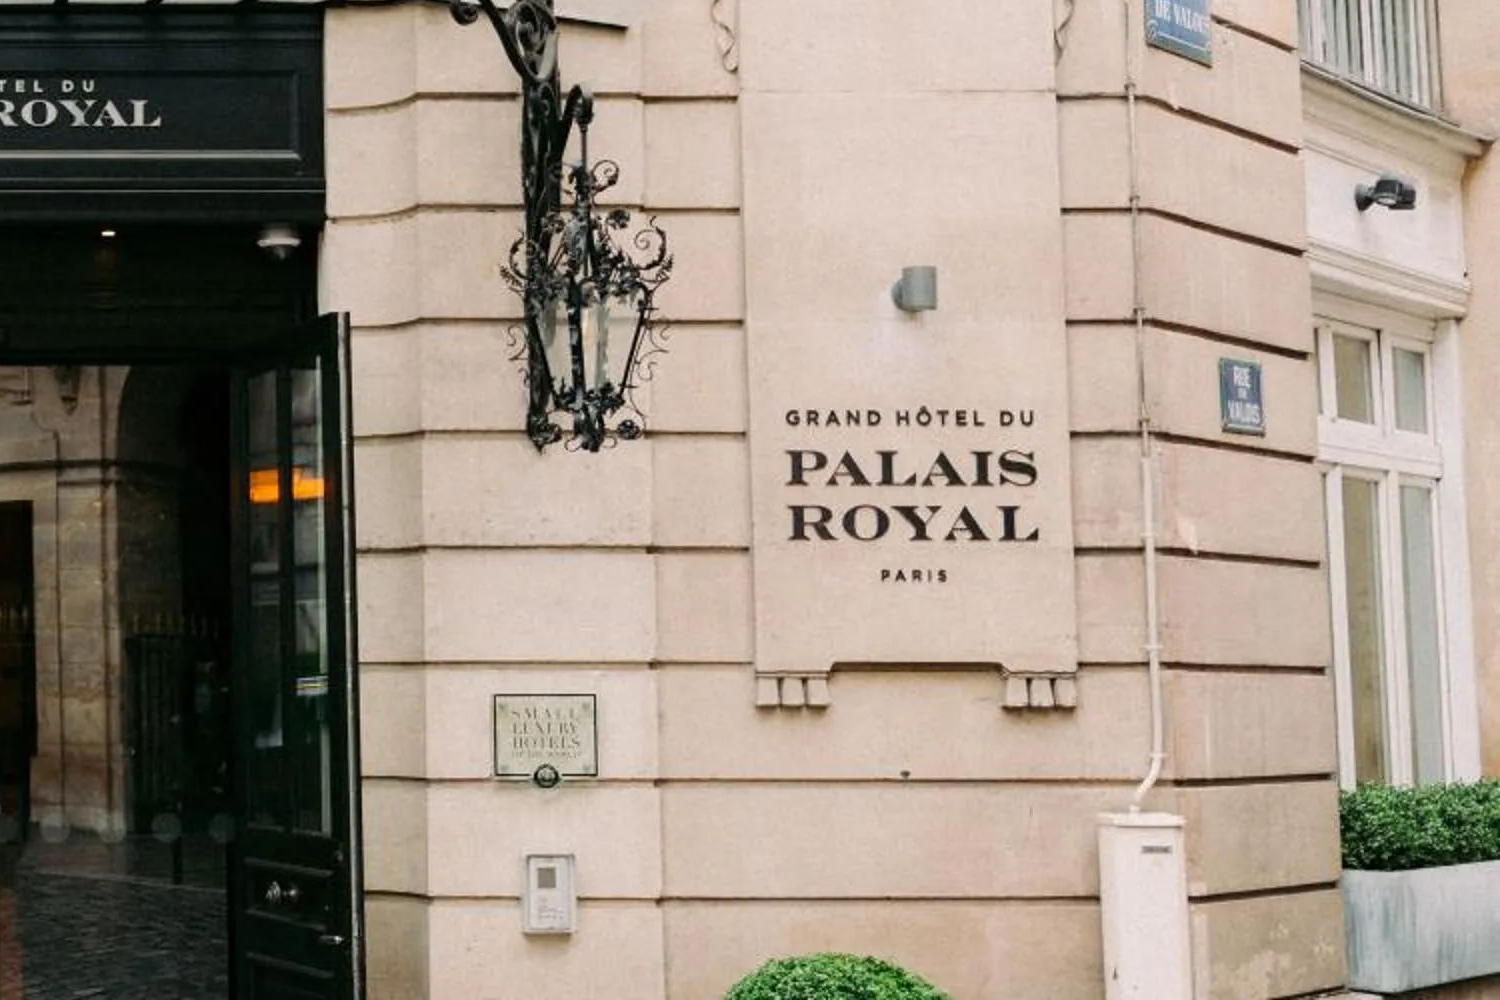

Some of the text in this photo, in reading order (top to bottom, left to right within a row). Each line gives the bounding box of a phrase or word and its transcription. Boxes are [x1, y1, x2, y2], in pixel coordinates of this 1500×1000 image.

[61, 79, 96, 93] DU
[785, 405, 1034, 428] GRAND HÔTEL DU
[785, 449, 1038, 487] PALAIS
[787, 504, 1040, 543] ROYAL
[880, 568, 948, 583] PARIS
